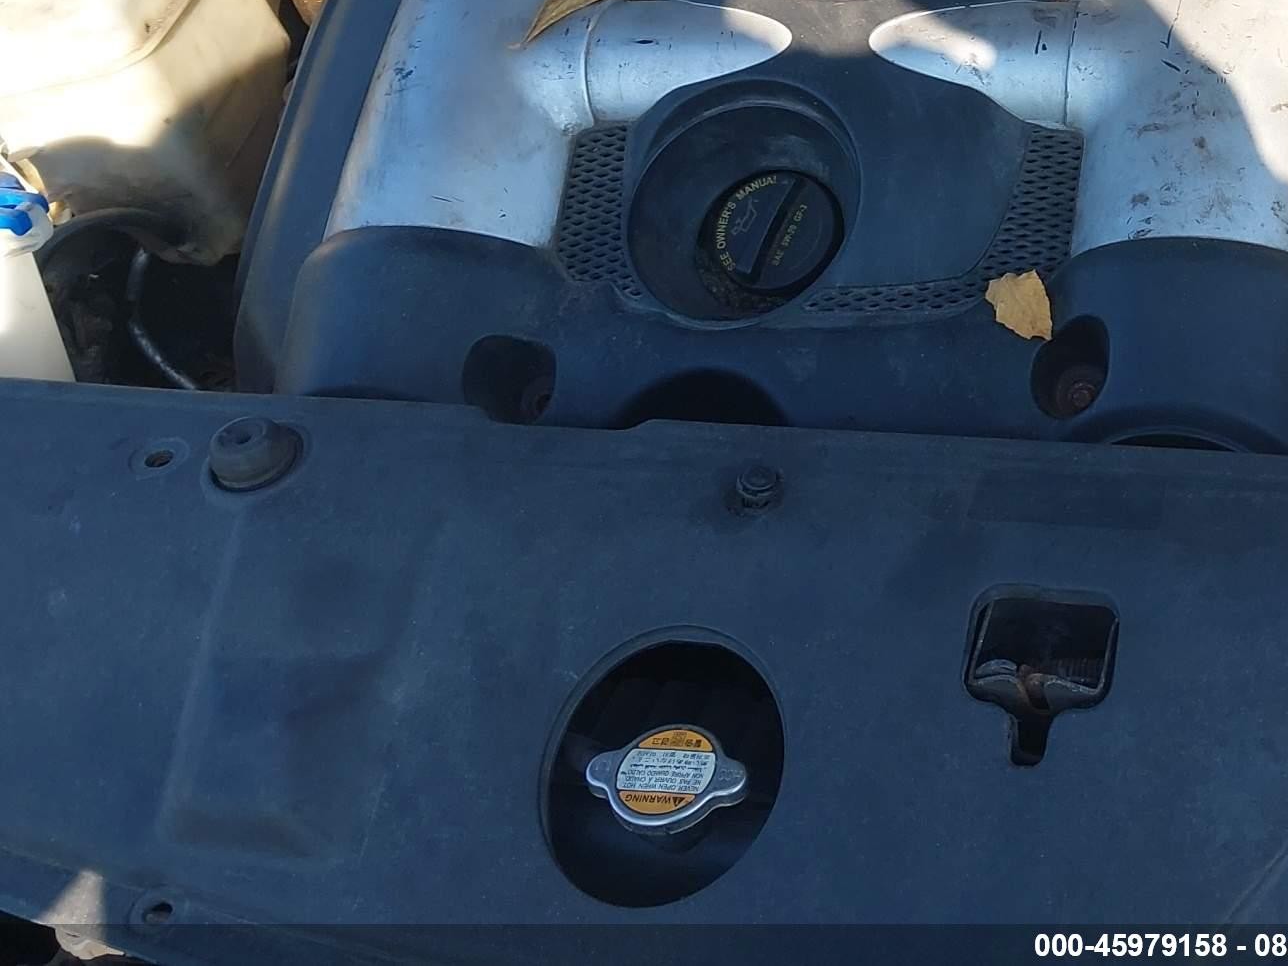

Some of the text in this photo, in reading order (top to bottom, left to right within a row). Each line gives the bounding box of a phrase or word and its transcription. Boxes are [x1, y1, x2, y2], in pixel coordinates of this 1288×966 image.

[716, 201, 737, 250] OWNER'S
[719, 251, 737, 272] SEE
[624, 794, 672, 804] WARNING
